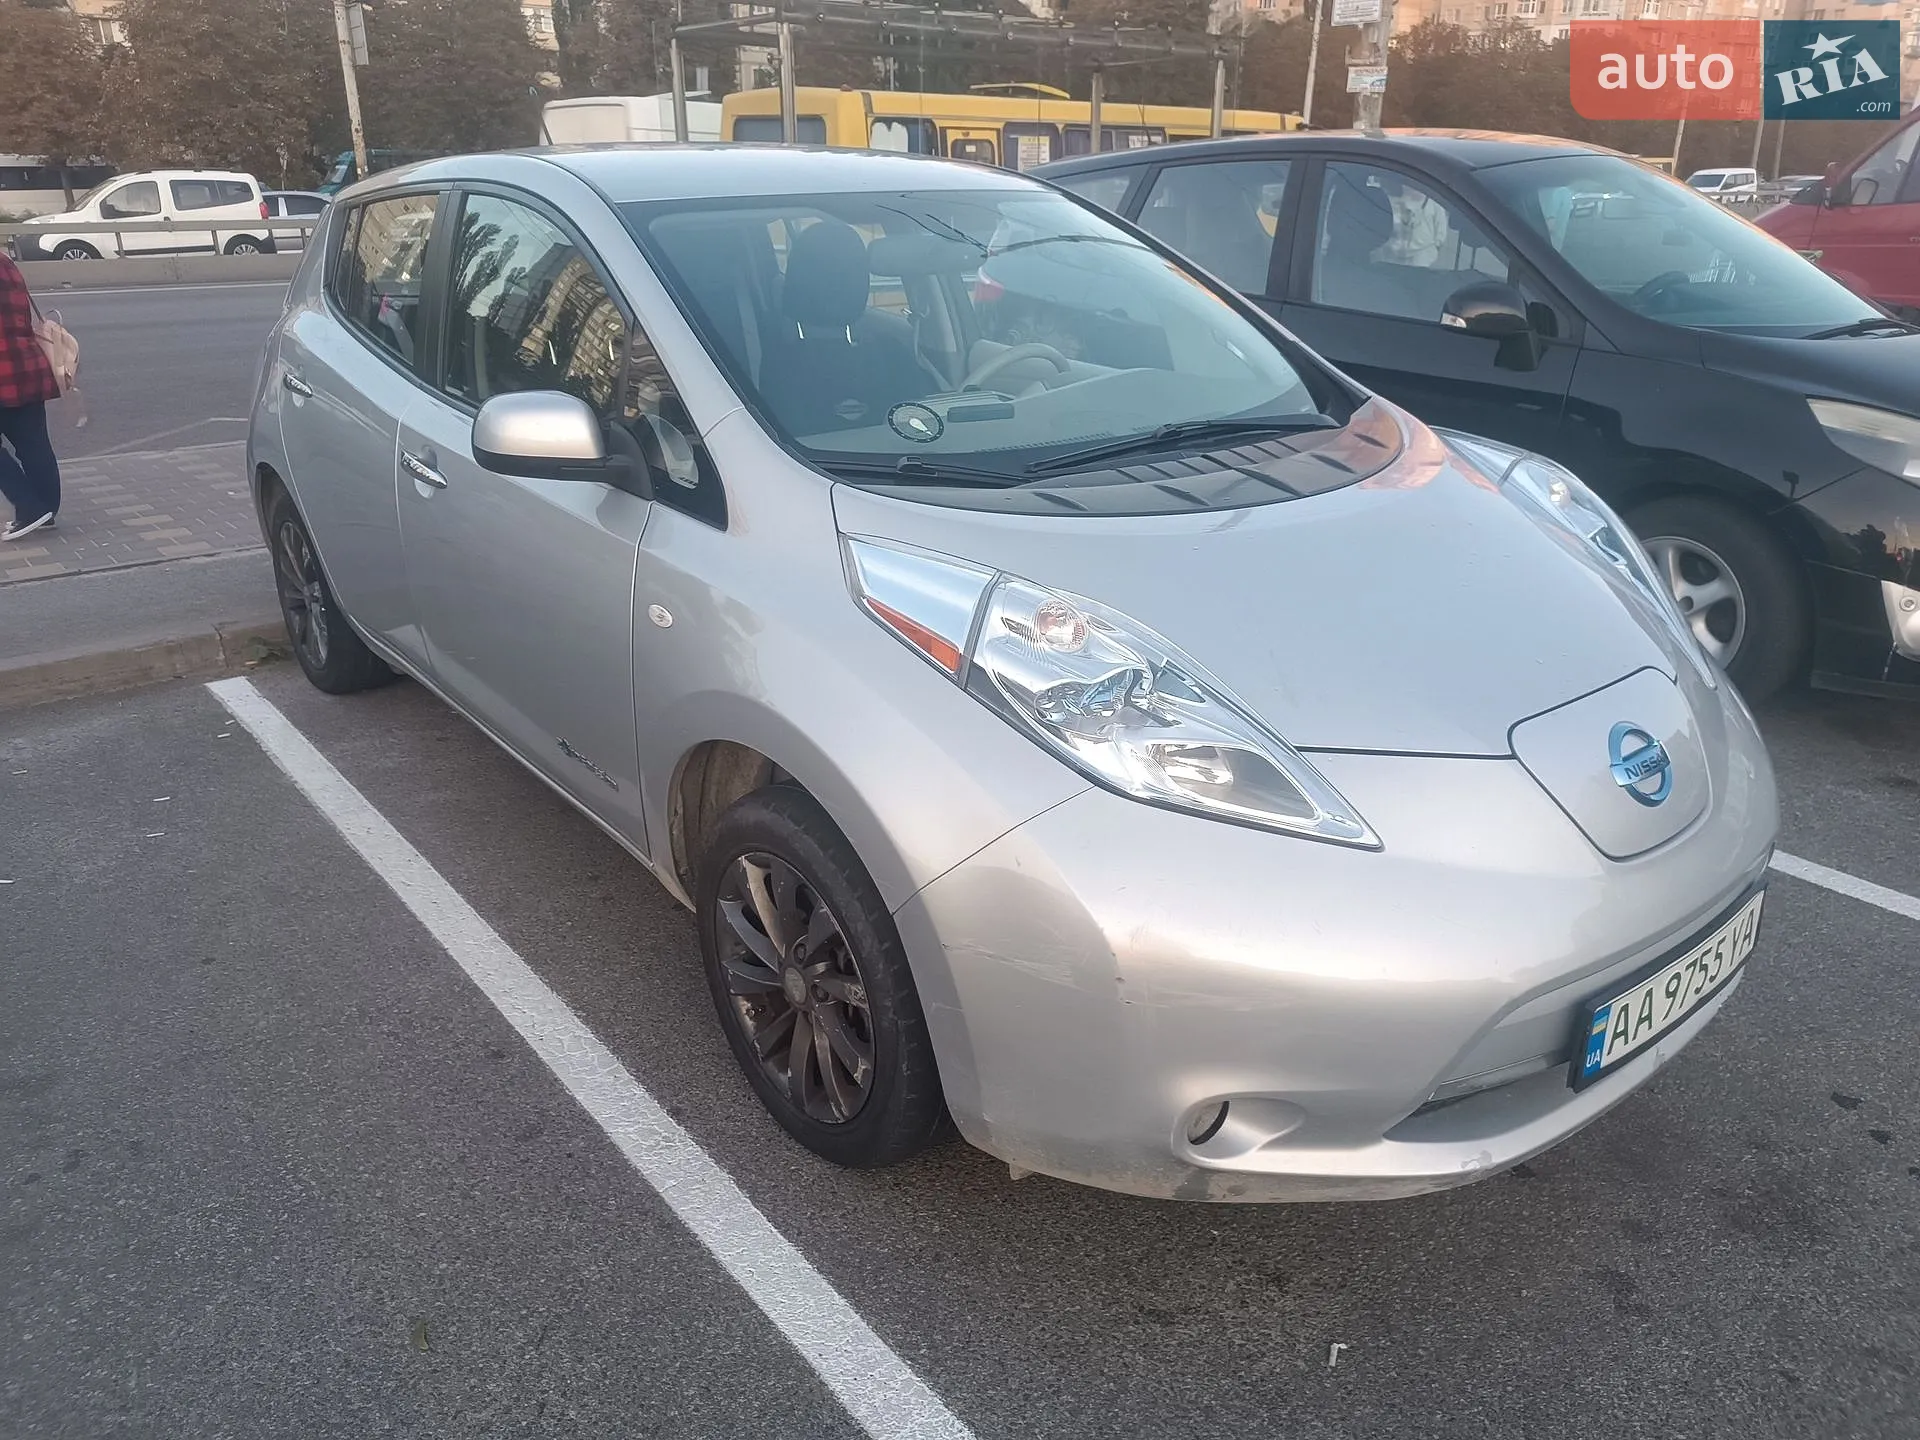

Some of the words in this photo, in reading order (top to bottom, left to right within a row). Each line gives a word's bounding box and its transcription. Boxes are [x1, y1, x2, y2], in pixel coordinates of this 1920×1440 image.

[1606, 987, 1654, 1057] AA
[1661, 935, 1727, 1022] 9755
[1729, 908, 1755, 967] YA
[1586, 1048, 1601, 1068] UA
